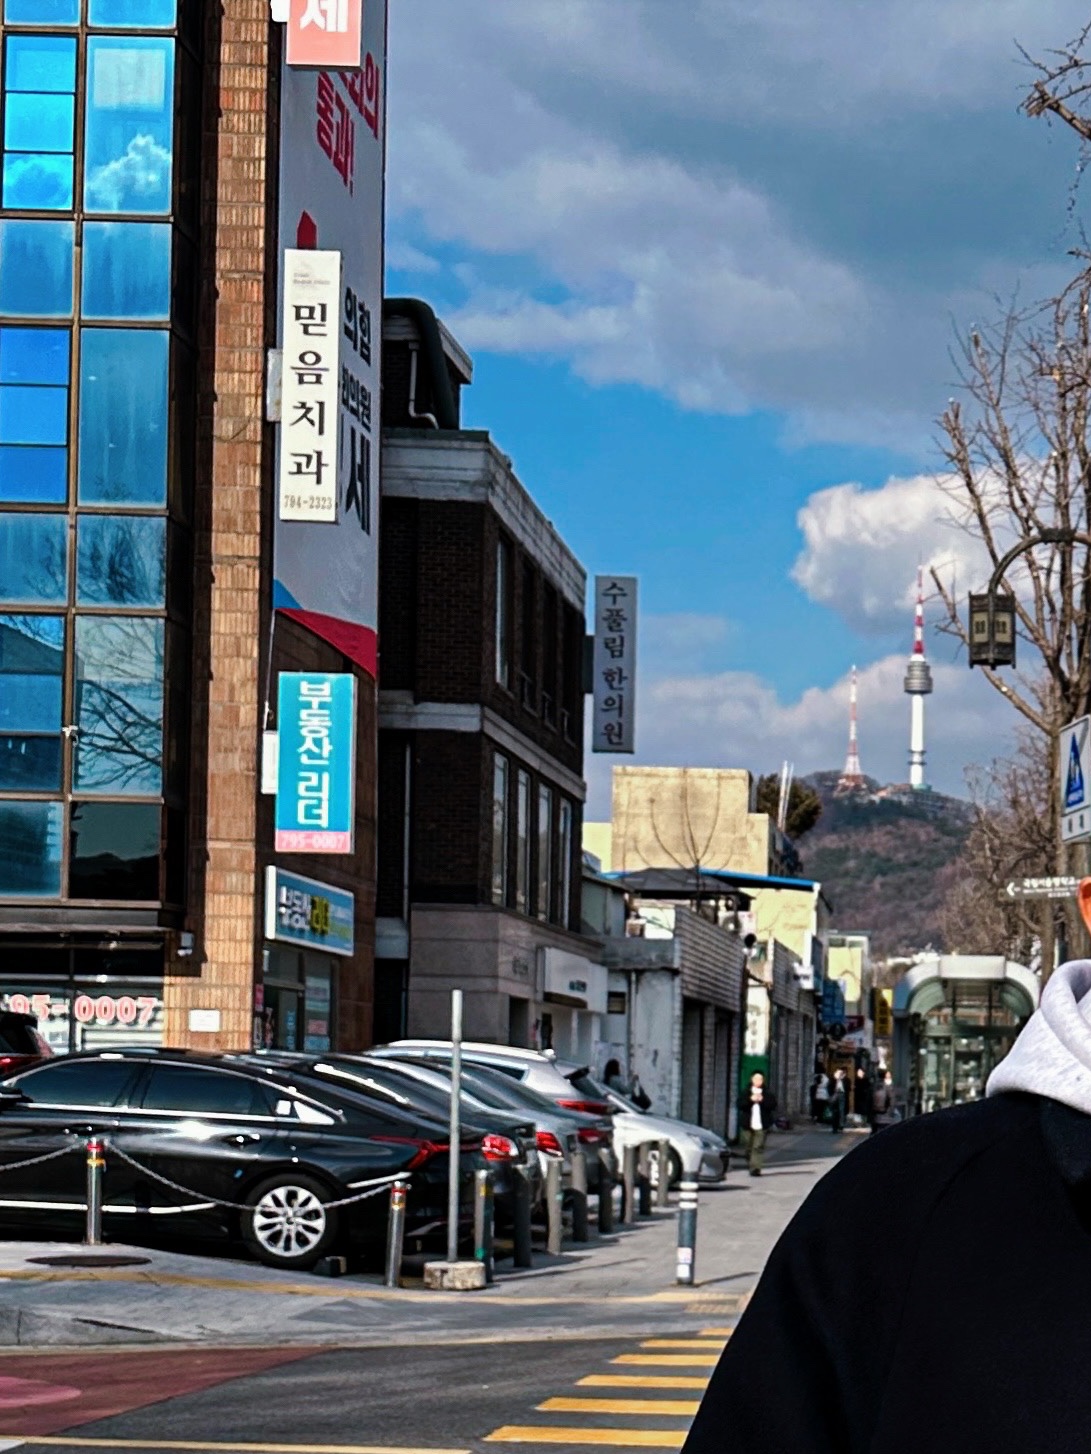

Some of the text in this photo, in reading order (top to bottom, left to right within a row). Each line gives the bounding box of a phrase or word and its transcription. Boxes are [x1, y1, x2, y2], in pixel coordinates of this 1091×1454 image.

[343, 286, 371, 367] 의힘
[289, 302, 330, 485] 믿음치과
[344, 426, 371, 536] 세
[601, 666, 628, 745] 한의원
[297, 680, 333, 828] 부동산 리더
[8, 993, 159, 1023] 95-0007
